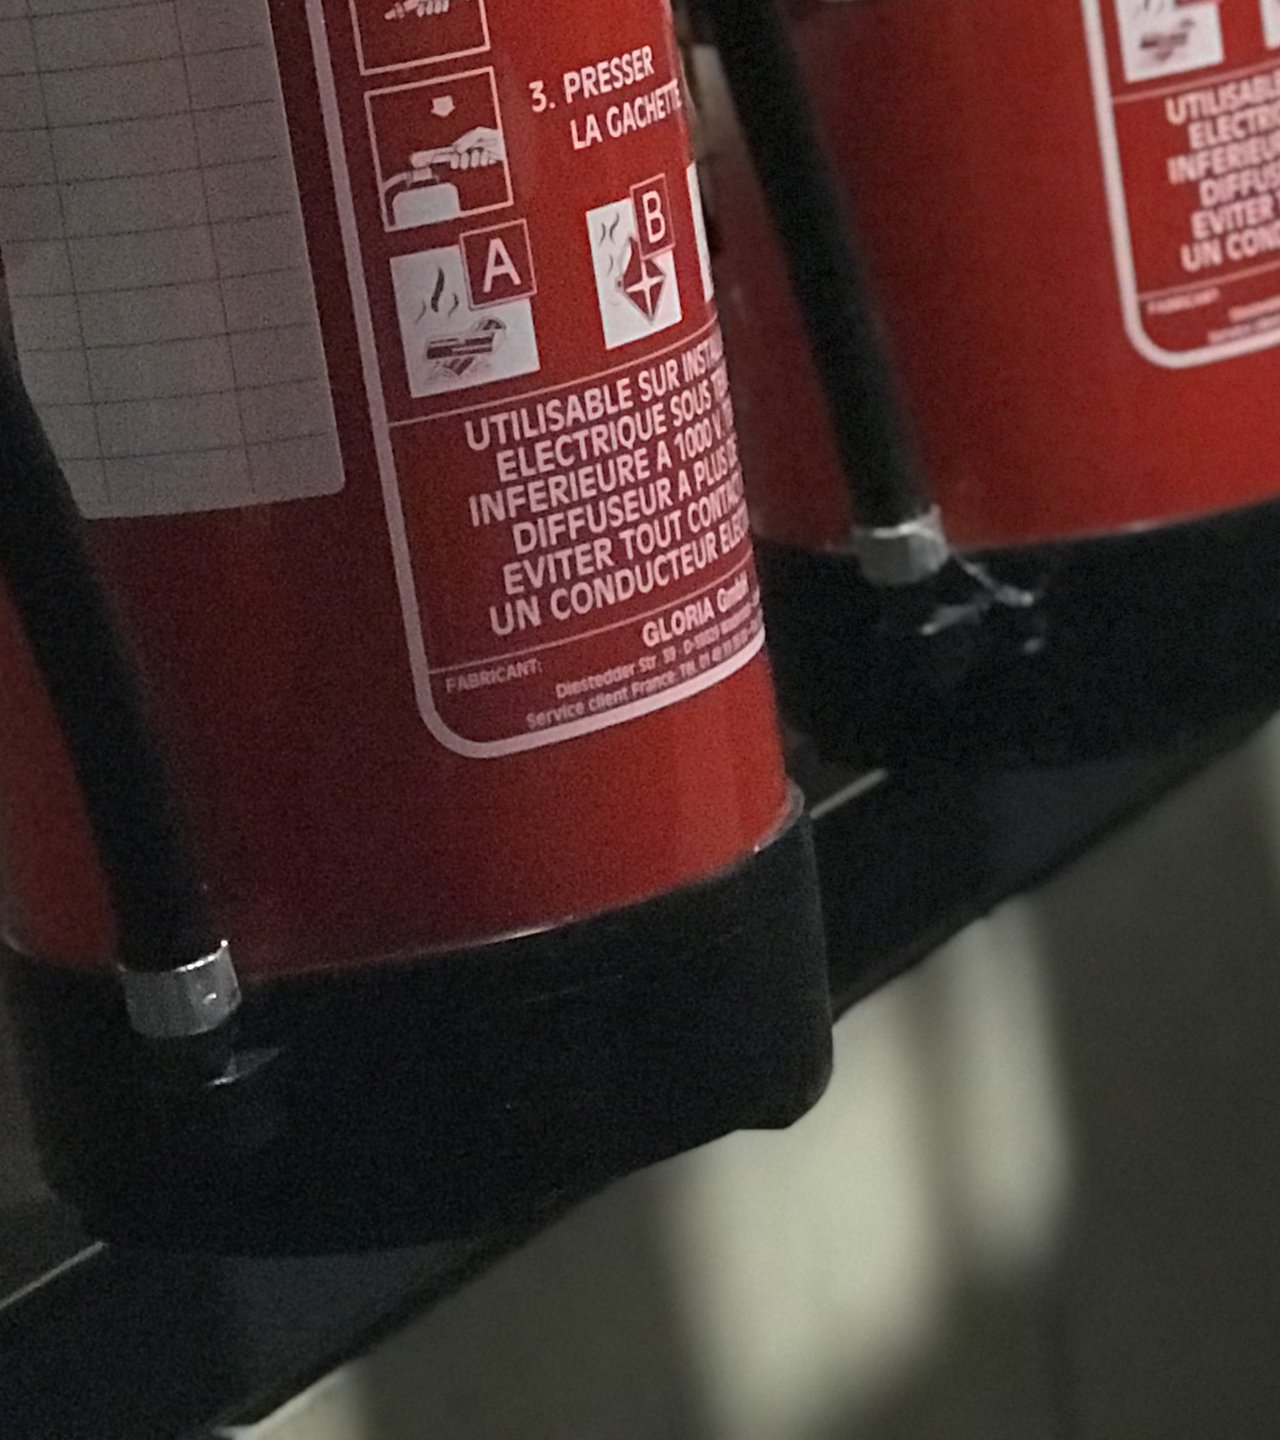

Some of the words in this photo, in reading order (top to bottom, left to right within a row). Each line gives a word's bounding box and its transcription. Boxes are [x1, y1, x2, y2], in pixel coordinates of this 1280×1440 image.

[529, 80, 556, 113] 3.
[563, 45, 655, 104] PRESSER
[570, 115, 603, 150] LA
[606, 78, 683, 138] GACHETTE
[642, 191, 666, 243] B
[482, 238, 520, 293] A
[465, 378, 634, 451] UTILISABLE
[638, 358, 680, 402] SUR
[496, 403, 667, 483] ELECTRIQUE
[670, 379, 711, 428] SOUS
[469, 448, 650, 527] INFERIEURE
[657, 440, 672, 472] A
[674, 418, 712, 461] 1000
[512, 478, 672, 554] DIFFUSEUR
[678, 469, 692, 501] A
[693, 449, 728, 492] PLUS
[489, 604, 541, 636] UN
[551, 531, 718, 621] CONDUCTEUR
[502, 537, 613, 596] EVITER
[621, 510, 682, 561] TOUT
[642, 597, 715, 646] GLORIA
[526, 702, 585, 730] Service
